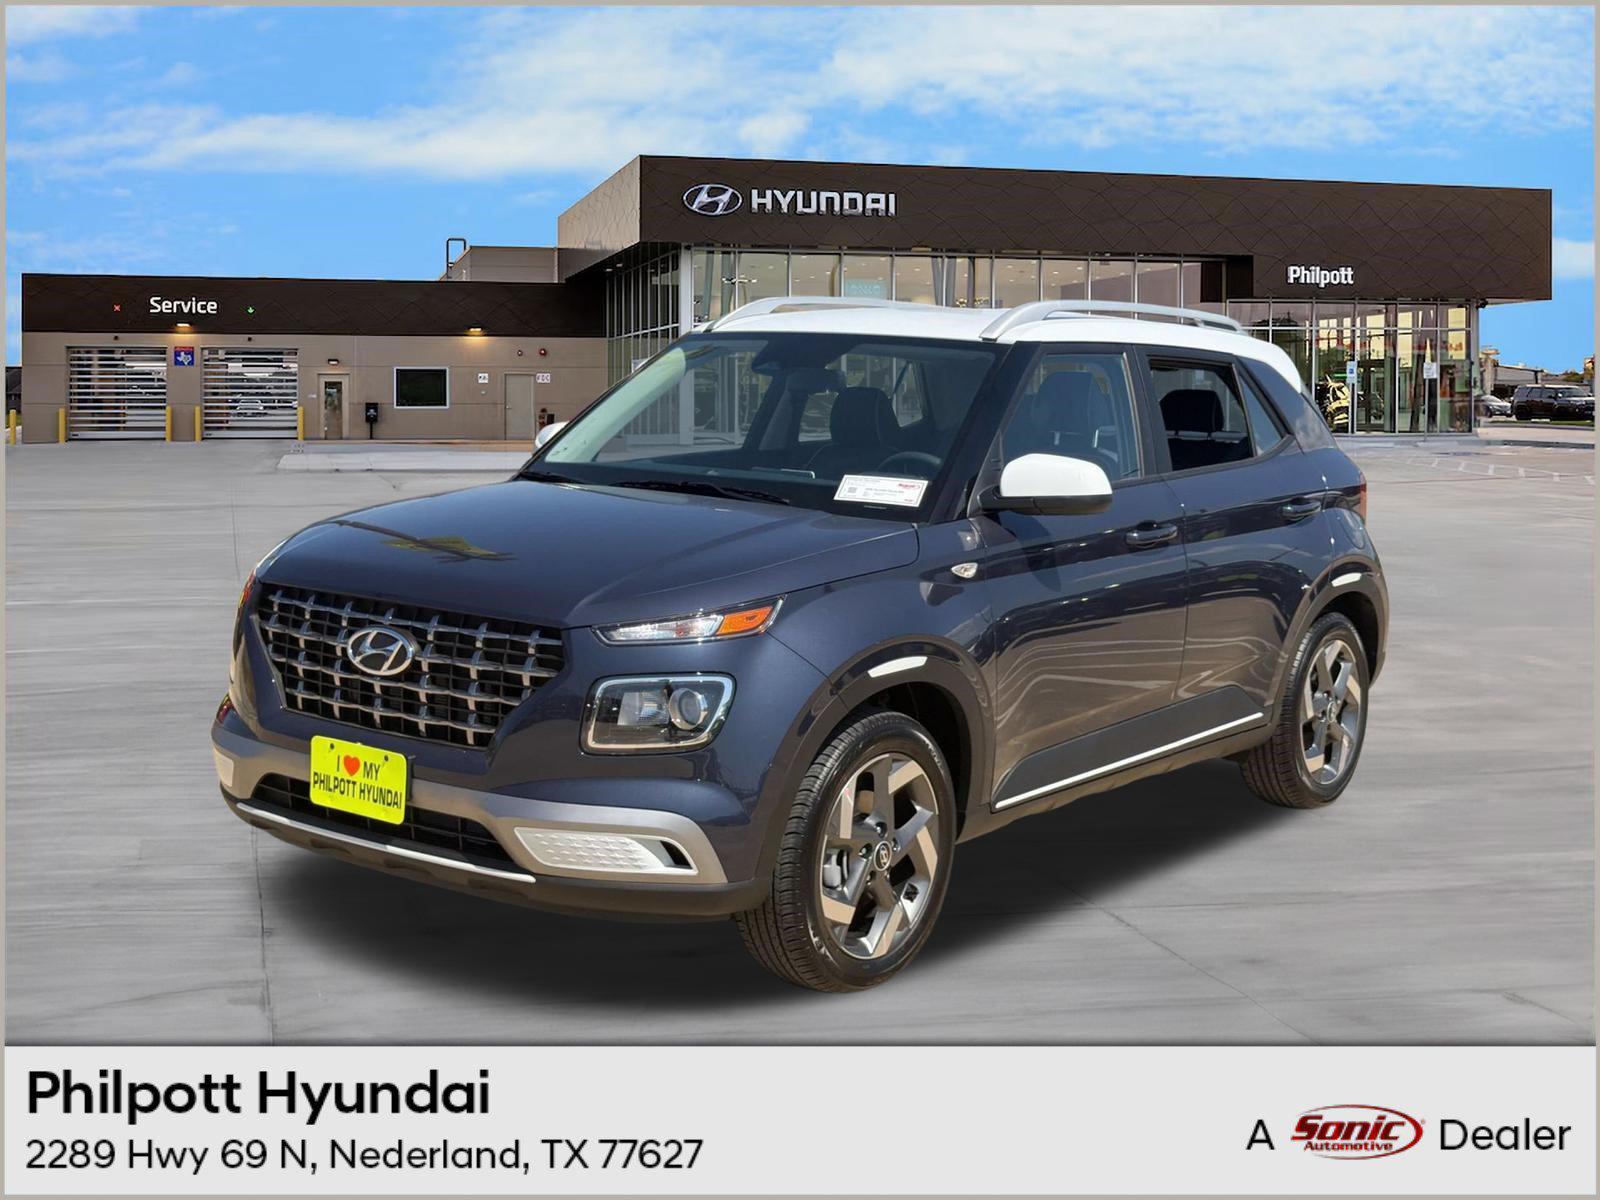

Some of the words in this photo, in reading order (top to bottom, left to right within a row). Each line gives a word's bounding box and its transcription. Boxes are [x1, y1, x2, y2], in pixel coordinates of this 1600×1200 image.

[751, 189, 896, 216] HYUNDAI
[1287, 265, 1354, 287] Philpott
[149, 296, 218, 314] Service
[336, 754, 341, 773] I
[363, 761, 381, 781] MY
[313, 772, 357, 798] PHILPOTT
[360, 783, 402, 809] HYUNDAI
